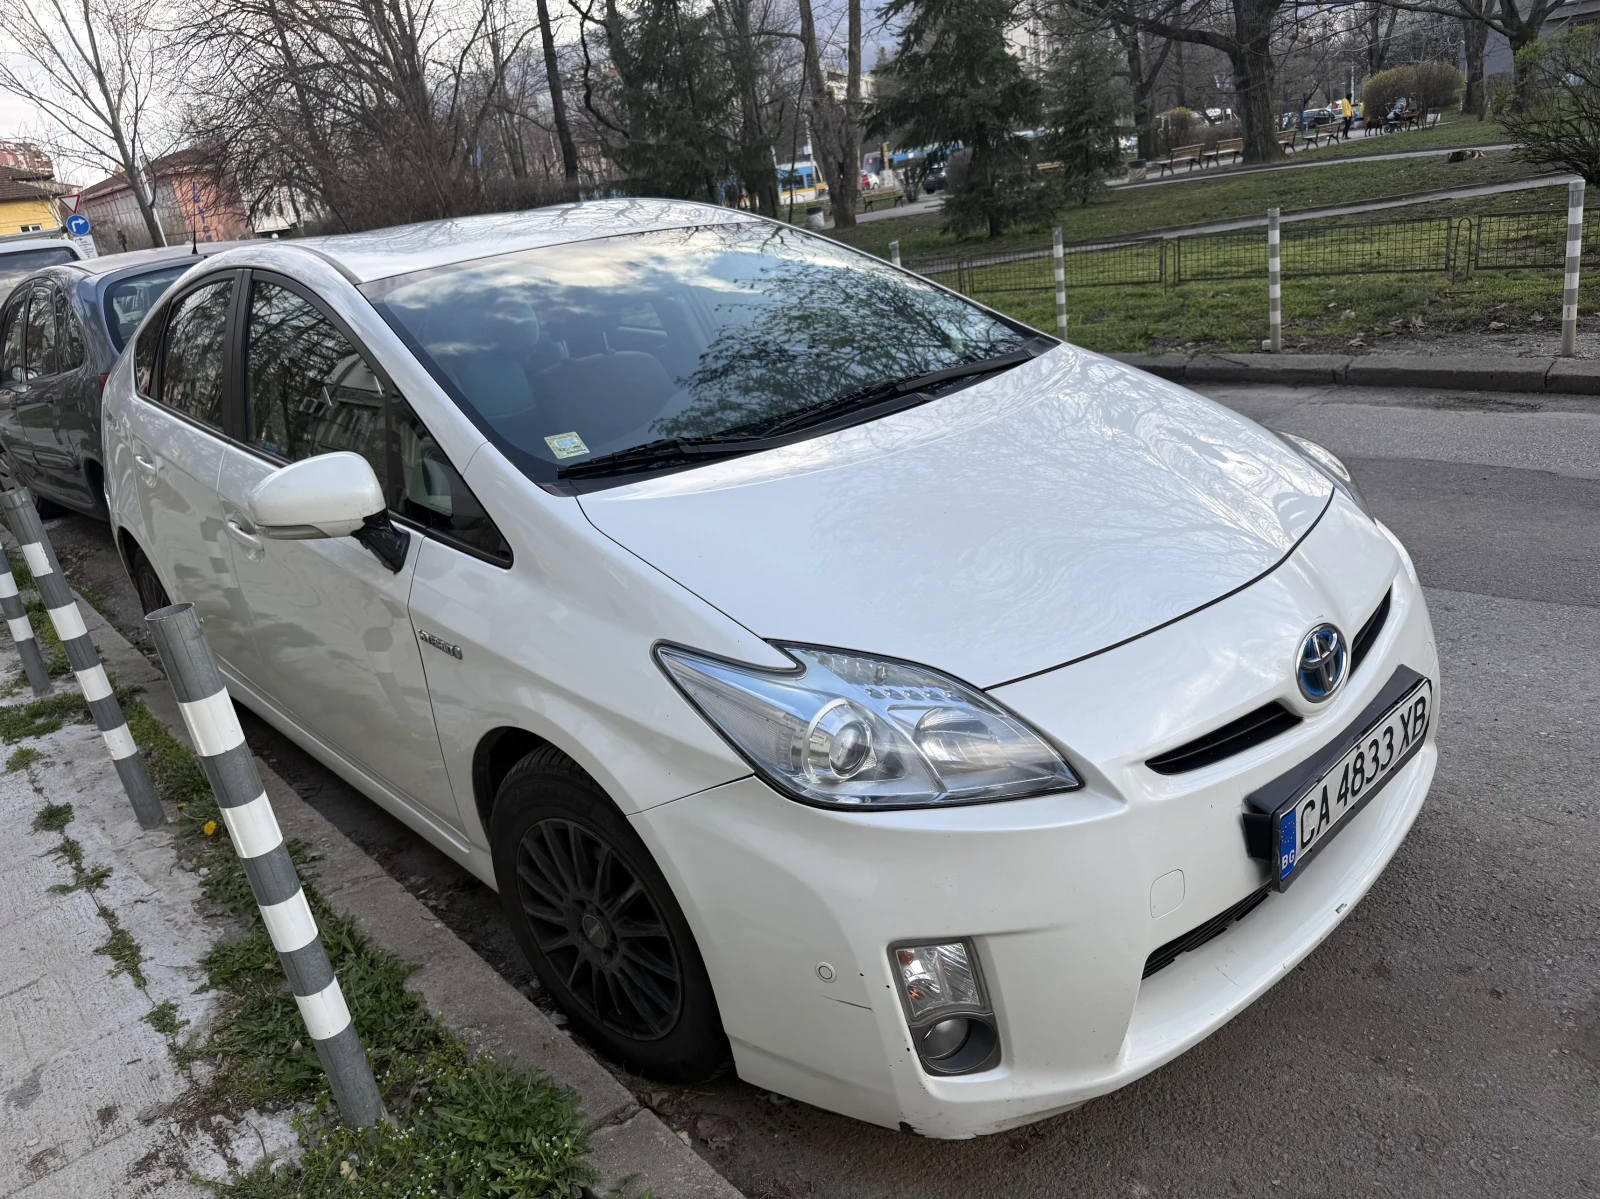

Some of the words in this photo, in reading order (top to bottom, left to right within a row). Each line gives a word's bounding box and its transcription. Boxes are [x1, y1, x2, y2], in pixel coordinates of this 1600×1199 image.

[1300, 784, 1330, 850] CA
[1336, 725, 1394, 807] 4833
[1398, 695, 1426, 756] XB
[1281, 849, 1295, 870] BG
